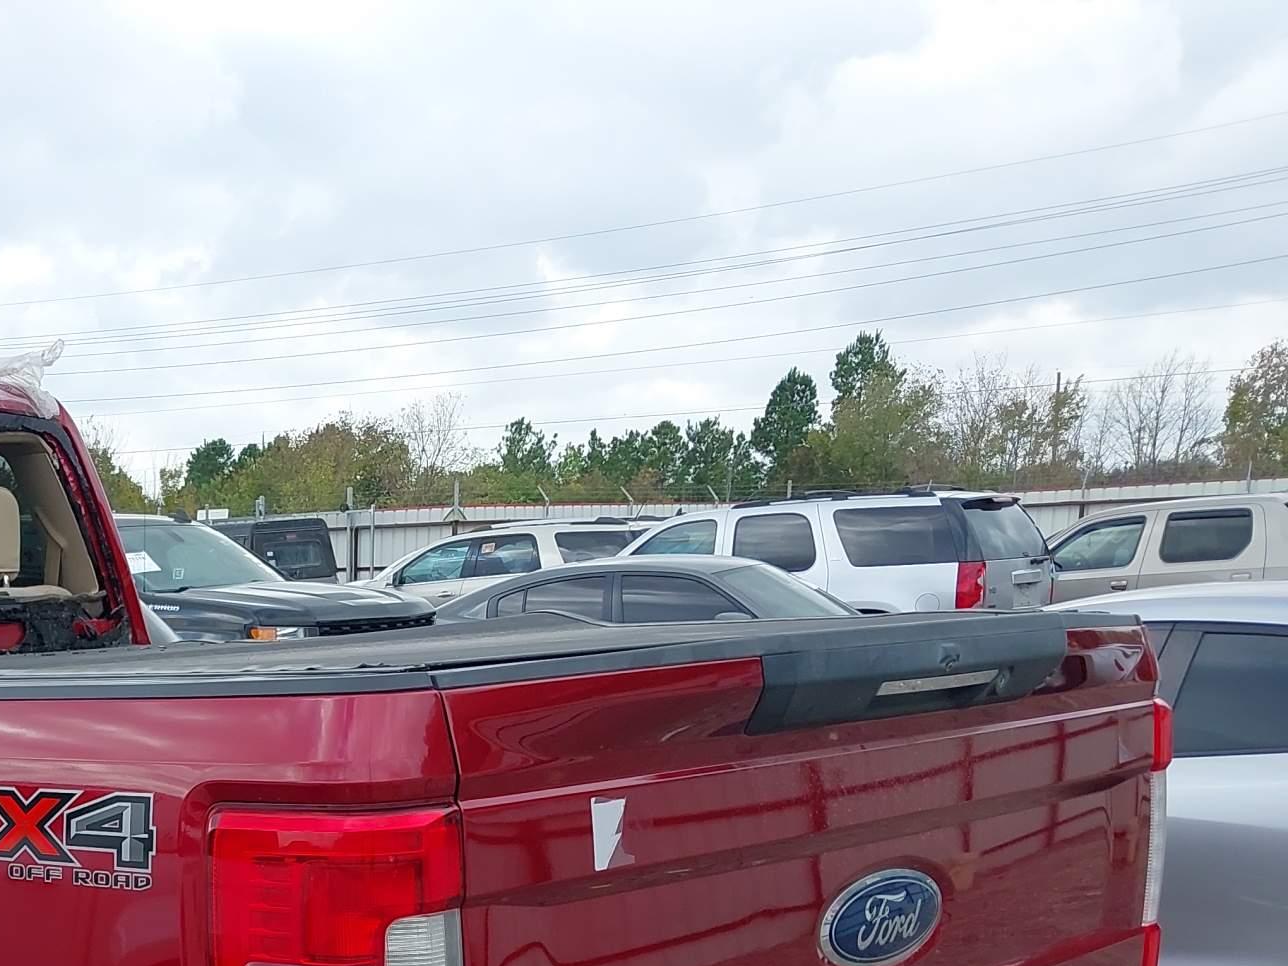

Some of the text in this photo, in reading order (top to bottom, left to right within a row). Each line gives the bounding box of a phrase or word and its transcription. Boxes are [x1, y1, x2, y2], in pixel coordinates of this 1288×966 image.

[8, 863, 152, 891] OFF ROAD
[857, 890, 921, 951] Ford
